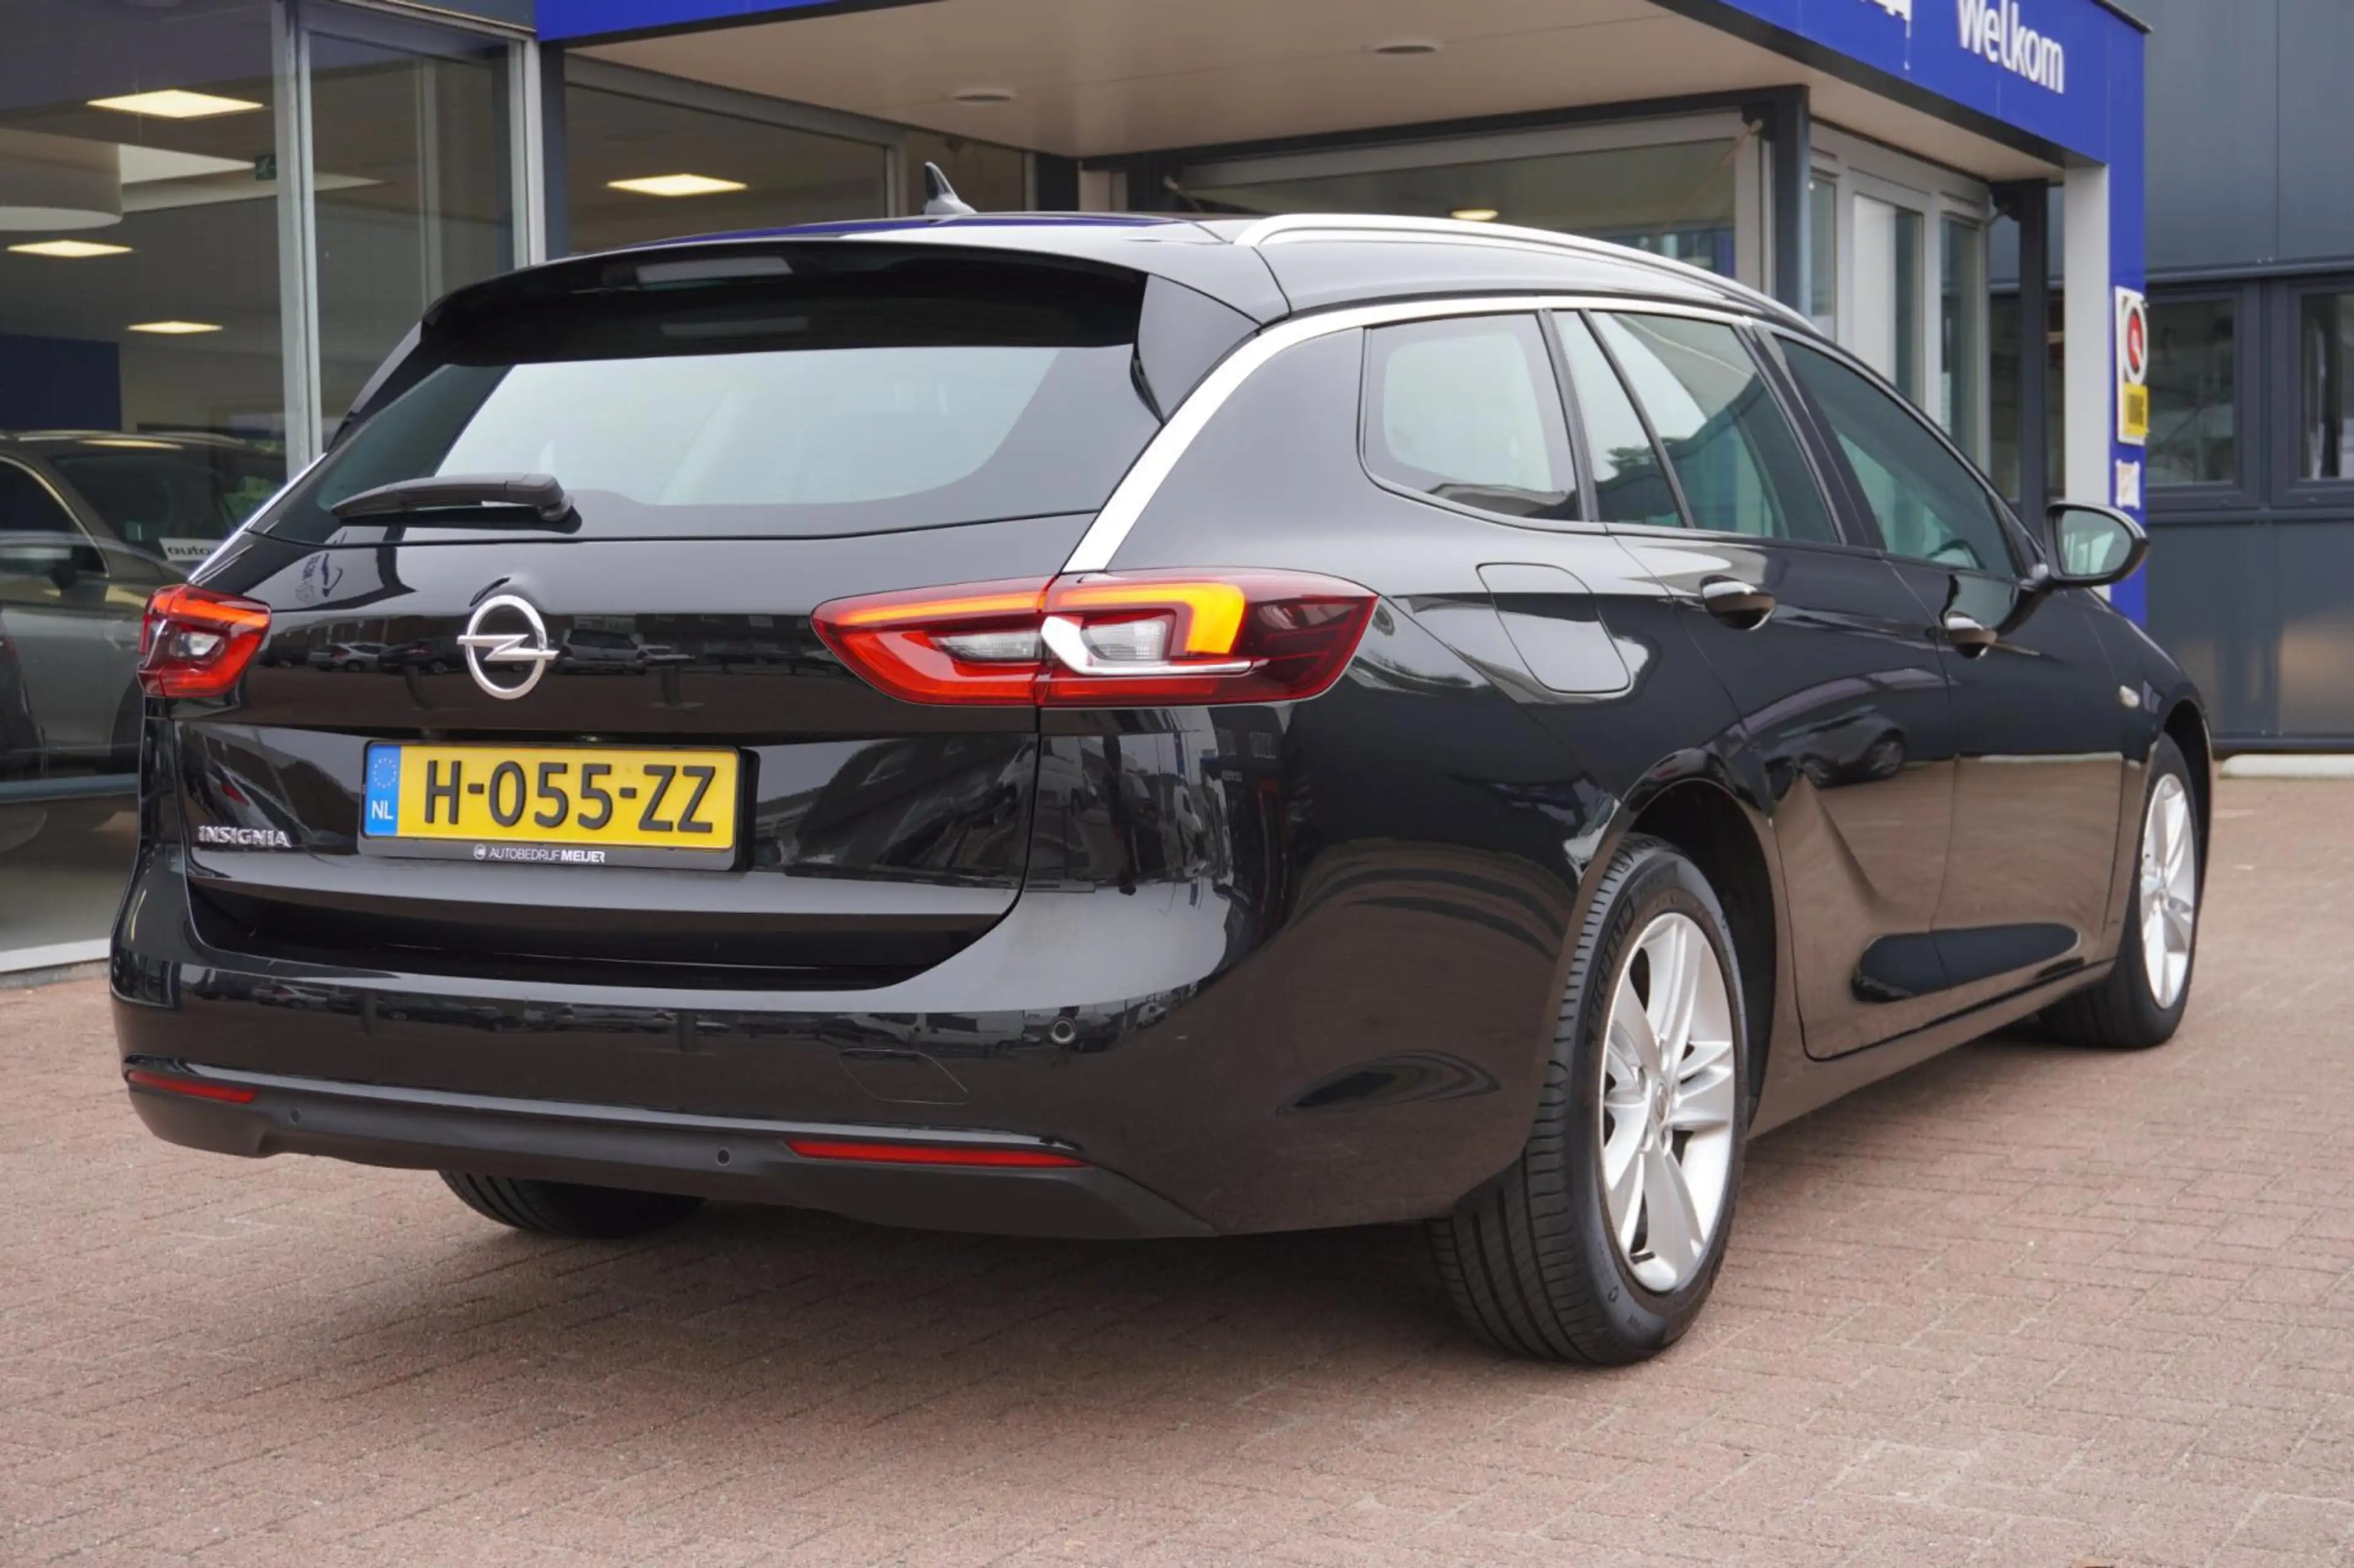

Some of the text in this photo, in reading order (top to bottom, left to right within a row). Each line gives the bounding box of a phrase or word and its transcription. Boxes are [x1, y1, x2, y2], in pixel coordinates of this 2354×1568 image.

[1957, 0, 2064, 94] Welkom
[371, 799, 394, 820] NL
[424, 759, 716, 833] H-055-ZZ
[198, 825, 292, 848] INSIGNIA
